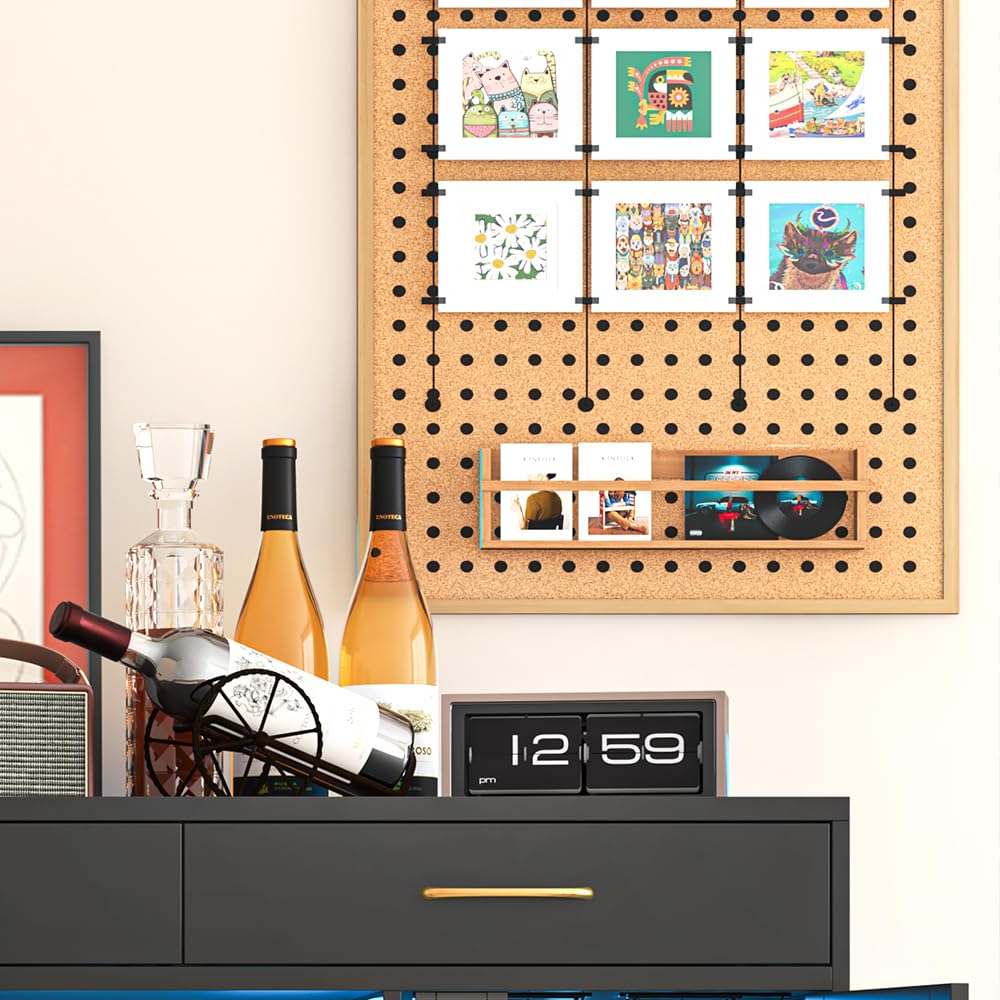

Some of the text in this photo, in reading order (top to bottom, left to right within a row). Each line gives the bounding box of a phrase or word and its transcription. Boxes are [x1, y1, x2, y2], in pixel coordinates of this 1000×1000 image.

[411, 746, 432, 755] OSO
[511, 732, 685, 766] 12 59
[478, 777, 497, 786] pm
